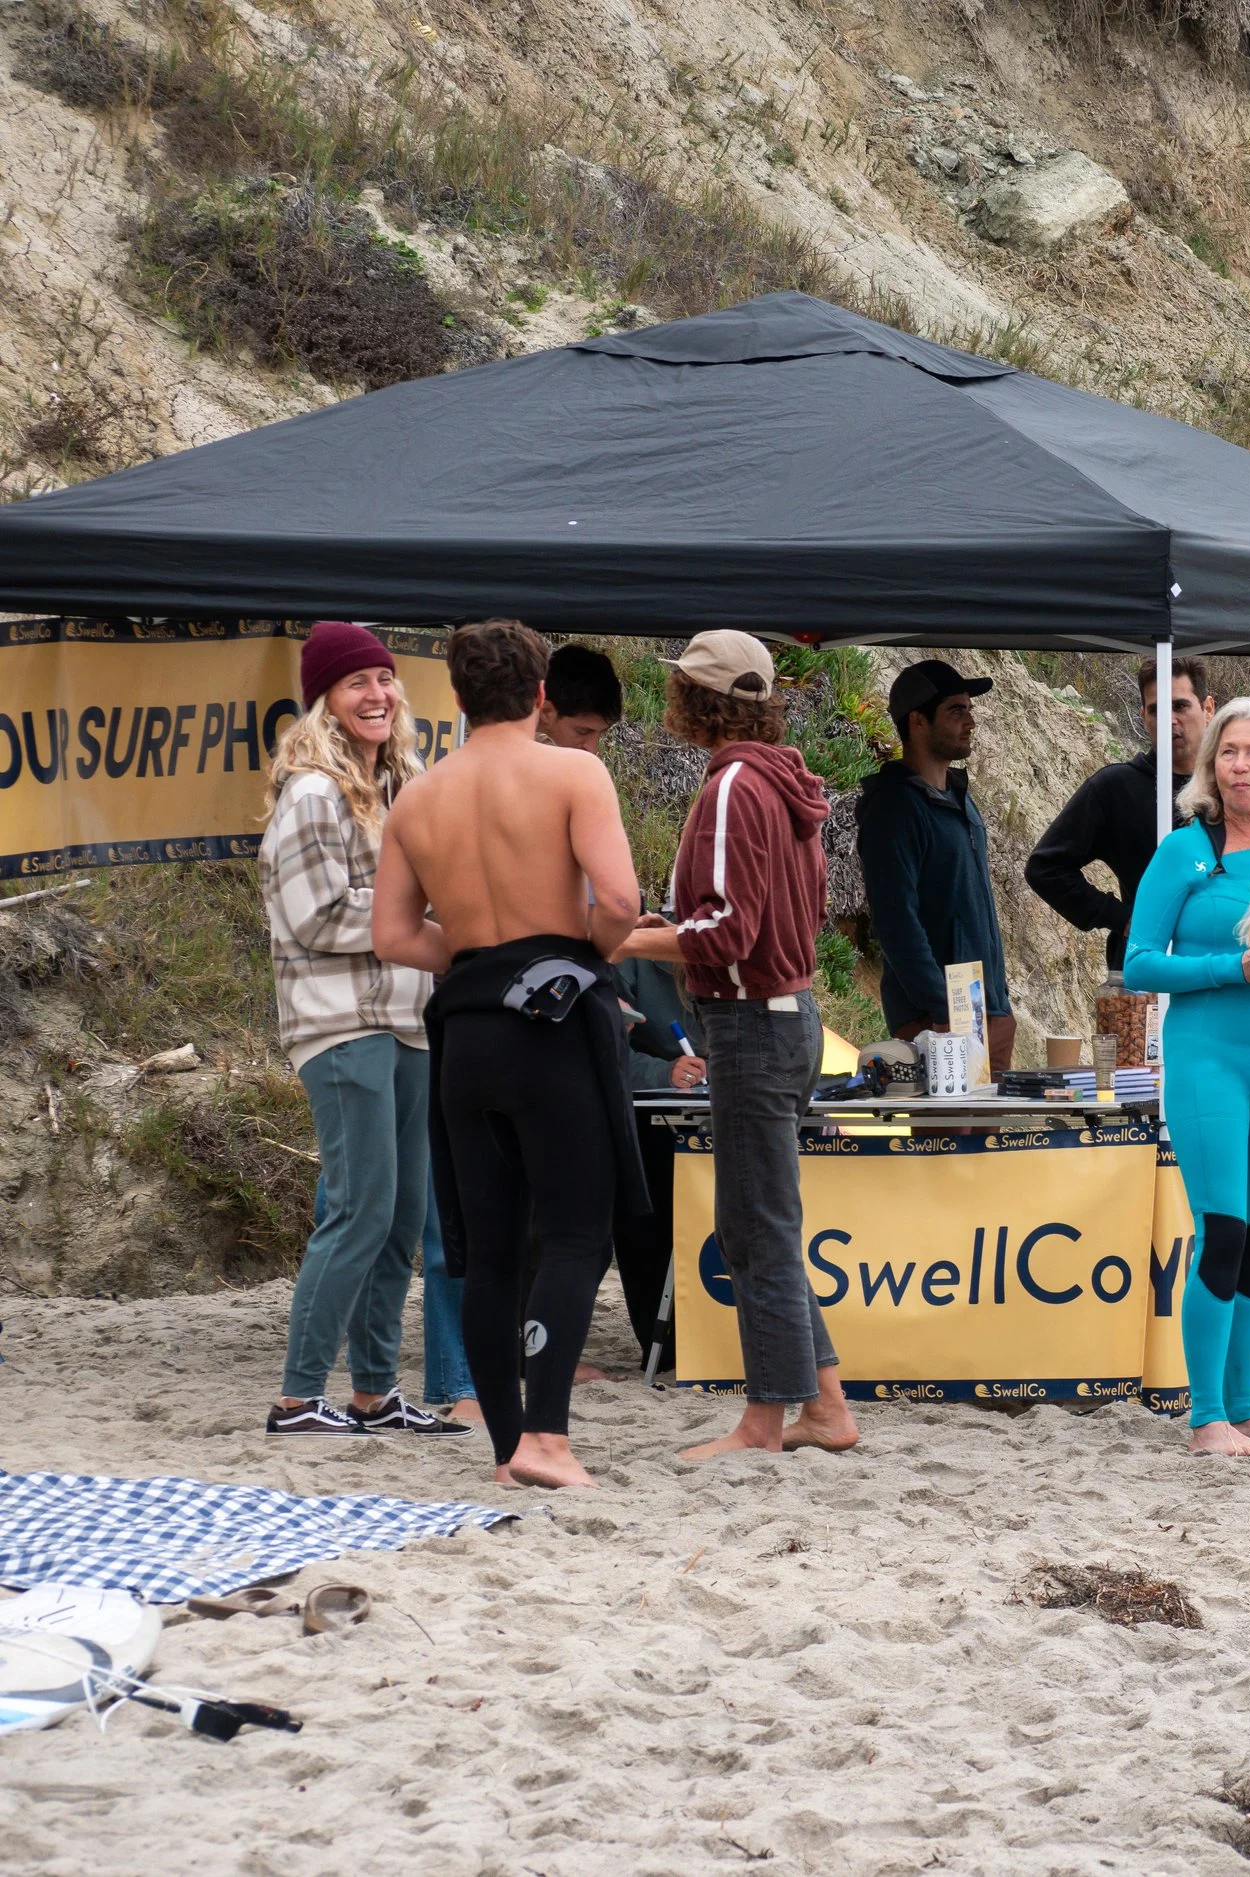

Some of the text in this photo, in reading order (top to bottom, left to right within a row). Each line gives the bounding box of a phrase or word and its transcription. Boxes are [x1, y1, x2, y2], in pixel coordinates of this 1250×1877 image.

[19, 624, 51, 641] SwellCo
[75, 621, 115, 639] SwellCo
[197, 620, 225, 637] SwellCo
[76, 705, 197, 780] SURF
[119, 844, 149, 862] SwellCo
[176, 840, 212, 860] SwellCo
[930, 1040, 938, 1080] SwellCo
[944, 1039, 954, 1080] SwellCo
[806, 1127, 1147, 1152] SwellCo SwellCo SwellCo SwellCo
[807, 1221, 1133, 1308] SwellCo
[891, 1383, 944, 1399] SwellCo
[992, 1382, 1046, 1398] SwellCo
[1093, 1381, 1138, 1397] SwellCo
